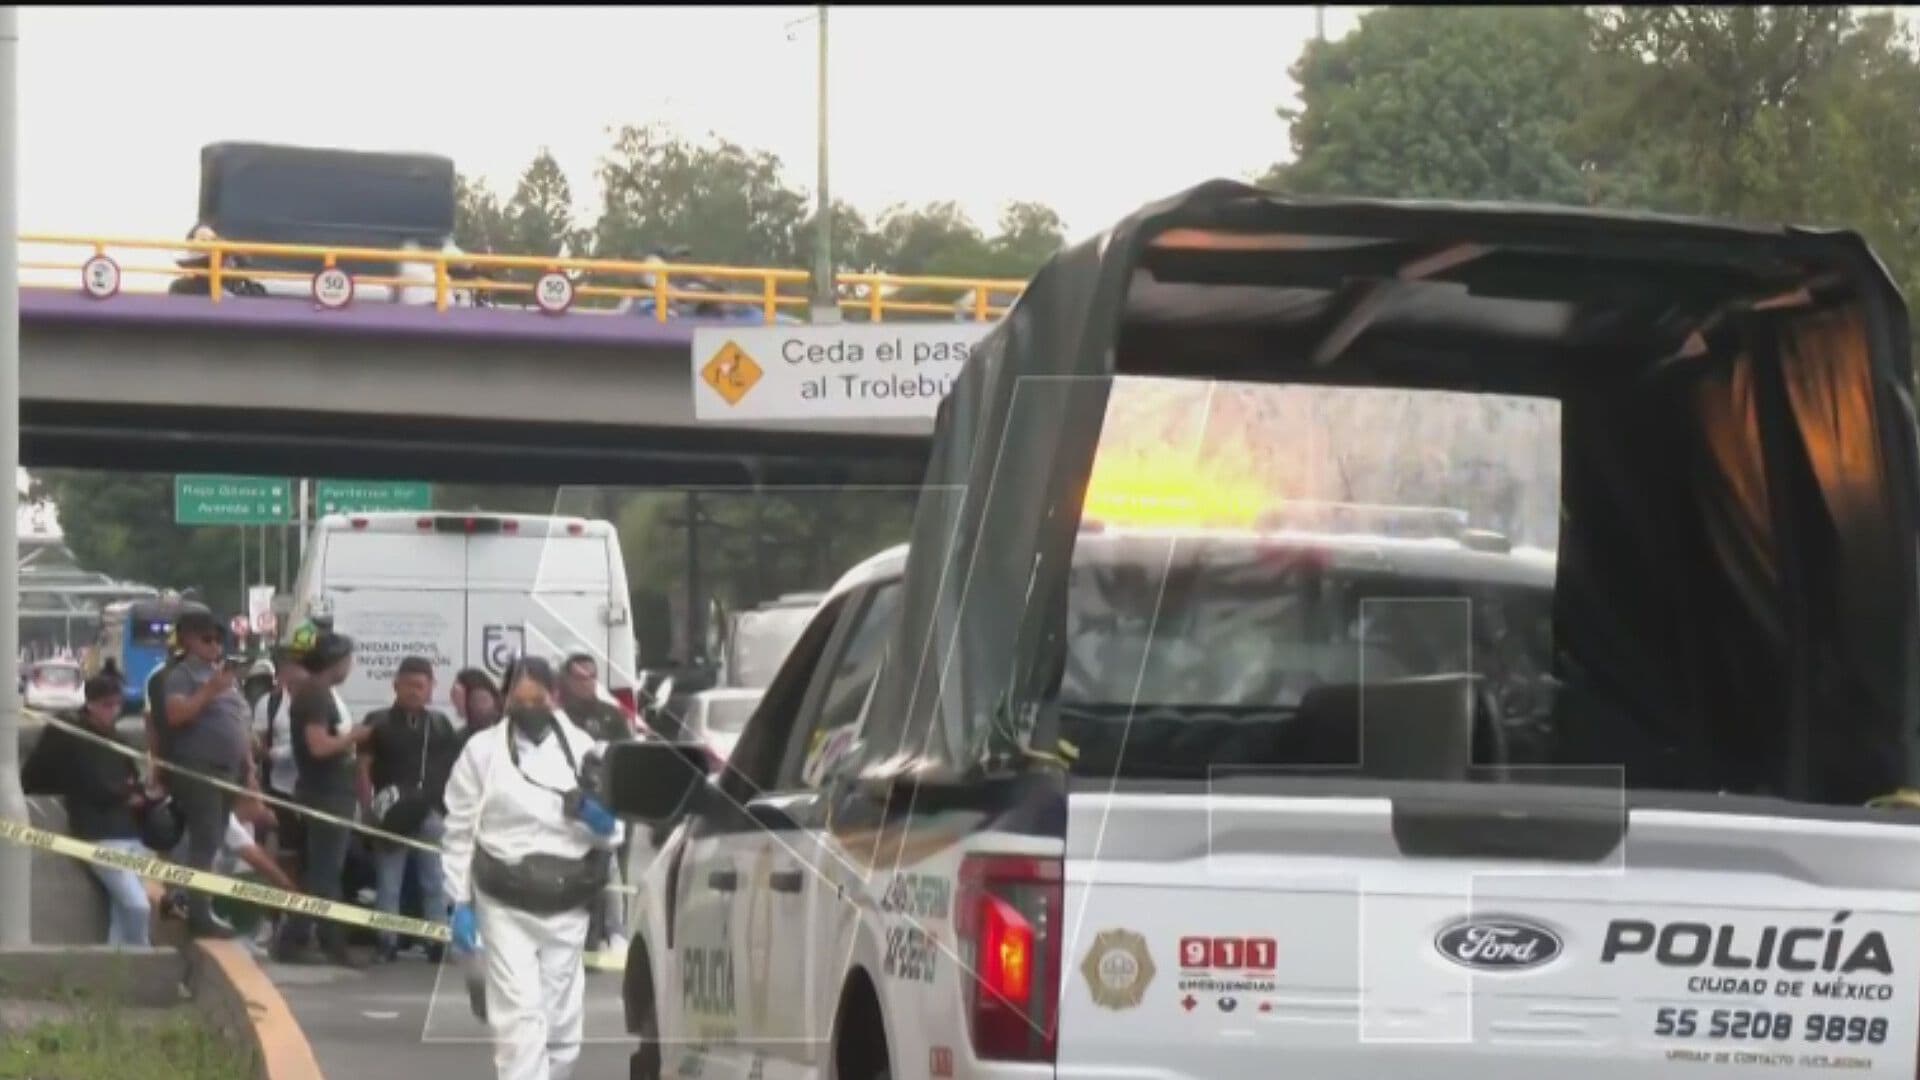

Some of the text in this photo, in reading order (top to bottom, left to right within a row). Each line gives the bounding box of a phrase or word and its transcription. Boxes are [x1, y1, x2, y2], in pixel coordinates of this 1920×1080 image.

[546, 280, 565, 295] 50
[782, 338, 974, 366] Ceda el pas
[801, 372, 952, 399] al Trolebú
[1183, 939, 1272, 967] 911
[1457, 925, 1538, 961] Ford
[1601, 910, 1894, 976] POLICÍA
[1687, 976, 1893, 1001] CIUDAD DE MÉXICO
[1654, 1008, 1888, 1044] 55 5208 9898
